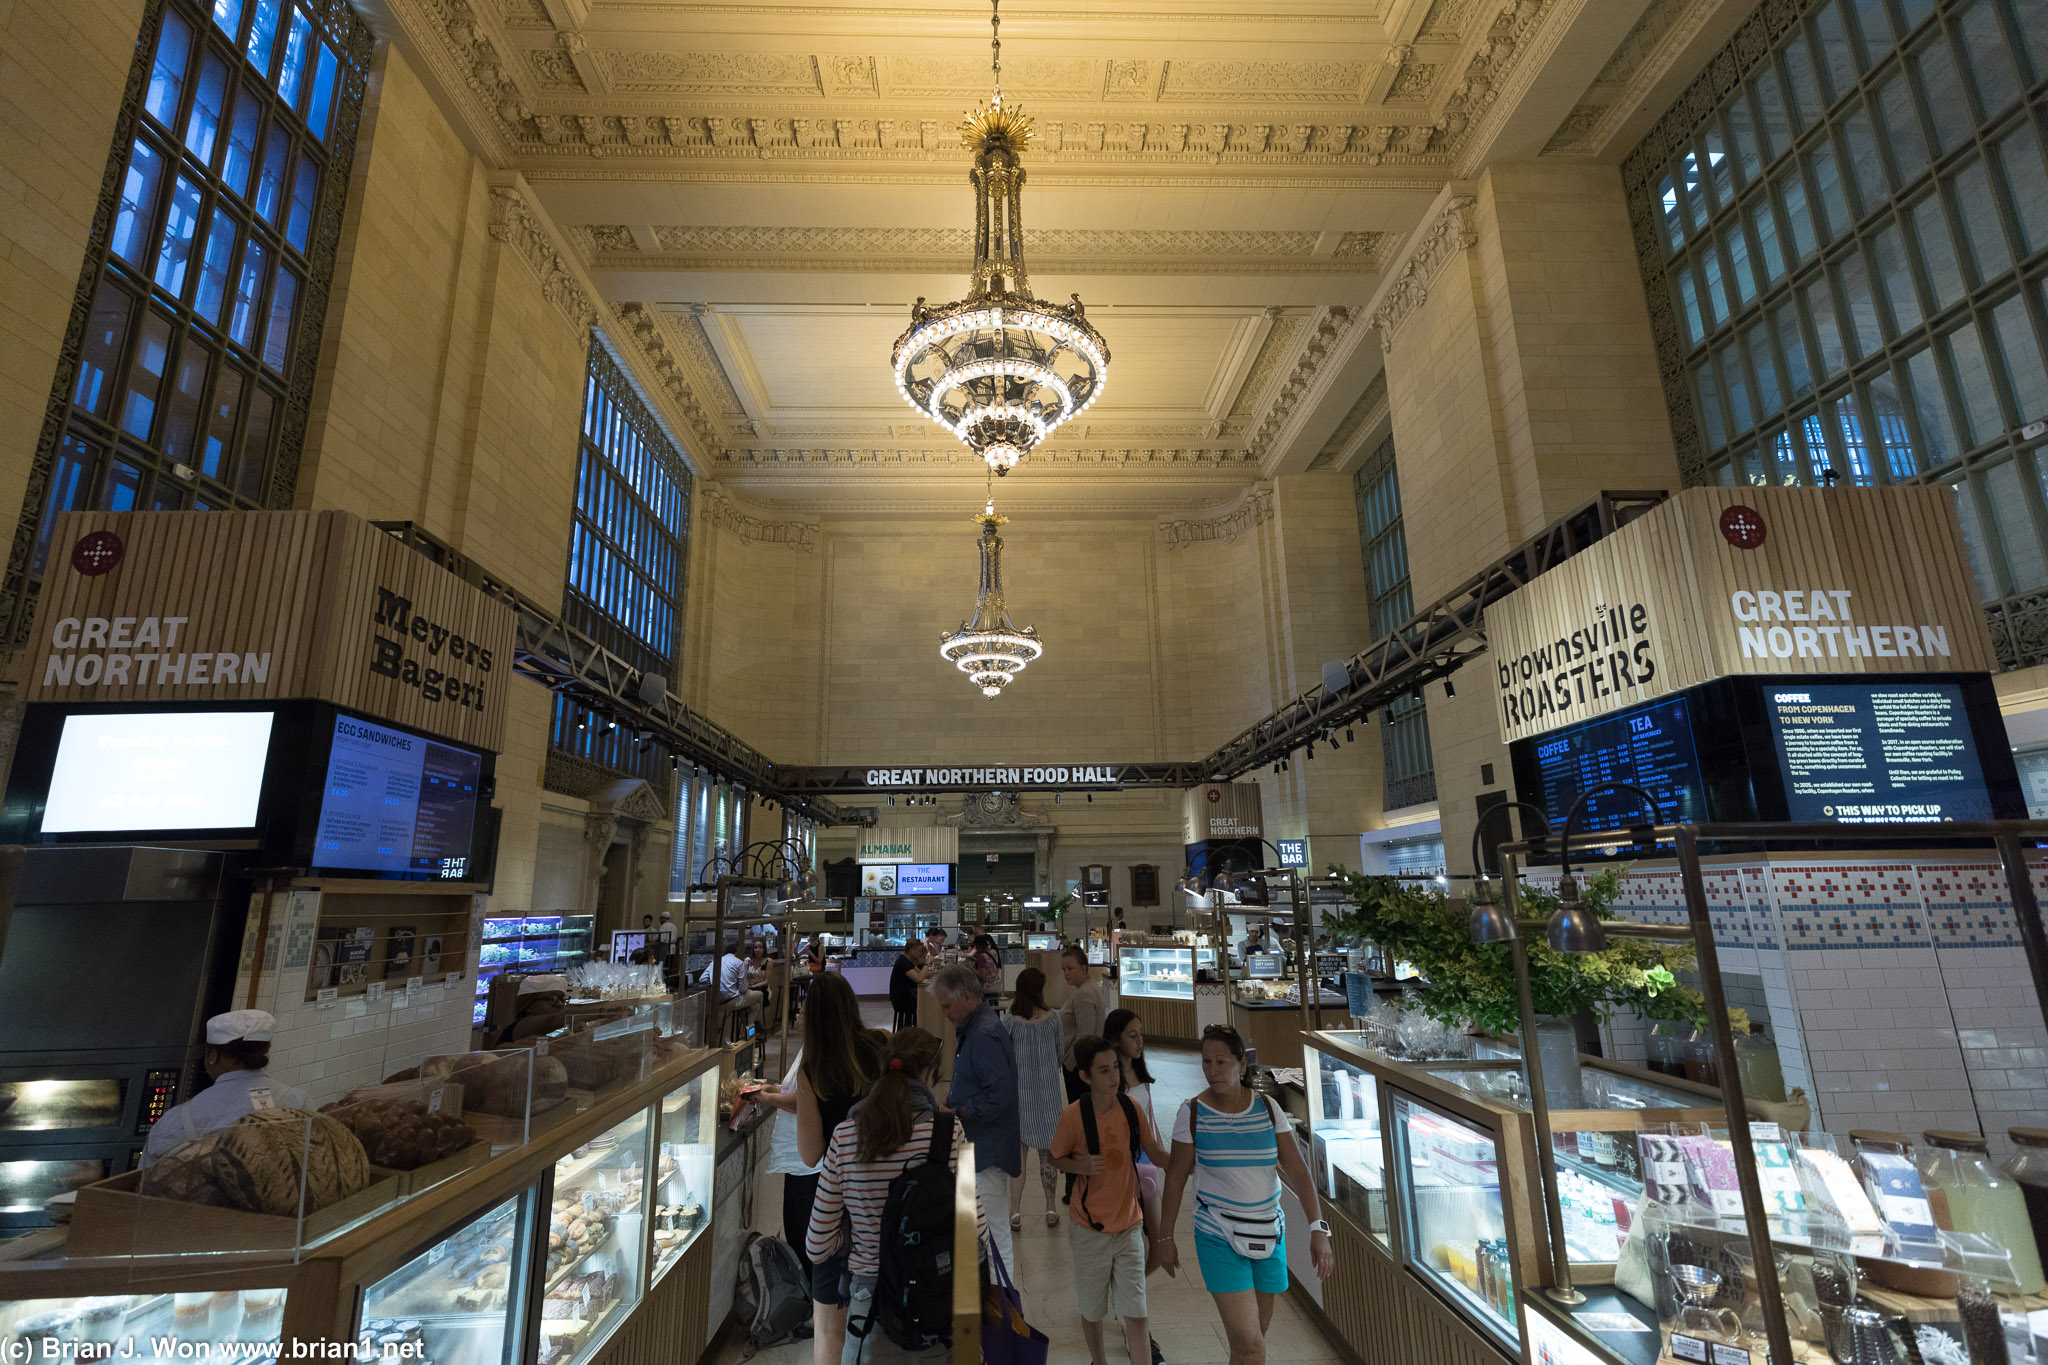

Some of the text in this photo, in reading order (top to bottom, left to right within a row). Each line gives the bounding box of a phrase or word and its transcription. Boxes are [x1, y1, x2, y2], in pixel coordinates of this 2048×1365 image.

[1732, 590, 1852, 622] GREAT
[52, 616, 188, 649] GREAT
[374, 586, 492, 672] Meyers
[1498, 603, 1647, 690] brownsville
[1738, 626, 1950, 658] NORTHERN
[42, 652, 271, 686] NORTHERN
[370, 634, 485, 712] Bageri
[1502, 640, 1654, 728] ROASTERS
[1774, 693, 1811, 703] COFFEE
[1778, 705, 1856, 714] FROM COPENHAGEN
[1629, 715, 1653, 732] TEA
[338, 722, 412, 751] EGG SANDWICHES
[1538, 740, 1570, 758] COFFEE
[866, 767, 1116, 785] GREAT NORTHERN FOOD HALL
[1836, 805, 1941, 816] THIS WAY TO PICK UP
[1210, 818, 1238, 826] GREAT
[1211, 826, 1259, 835] NORTHERN
[860, 844, 911, 854] ALMANAK
[1280, 843, 1302, 853] THE
[1282, 854, 1303, 864] BAR
